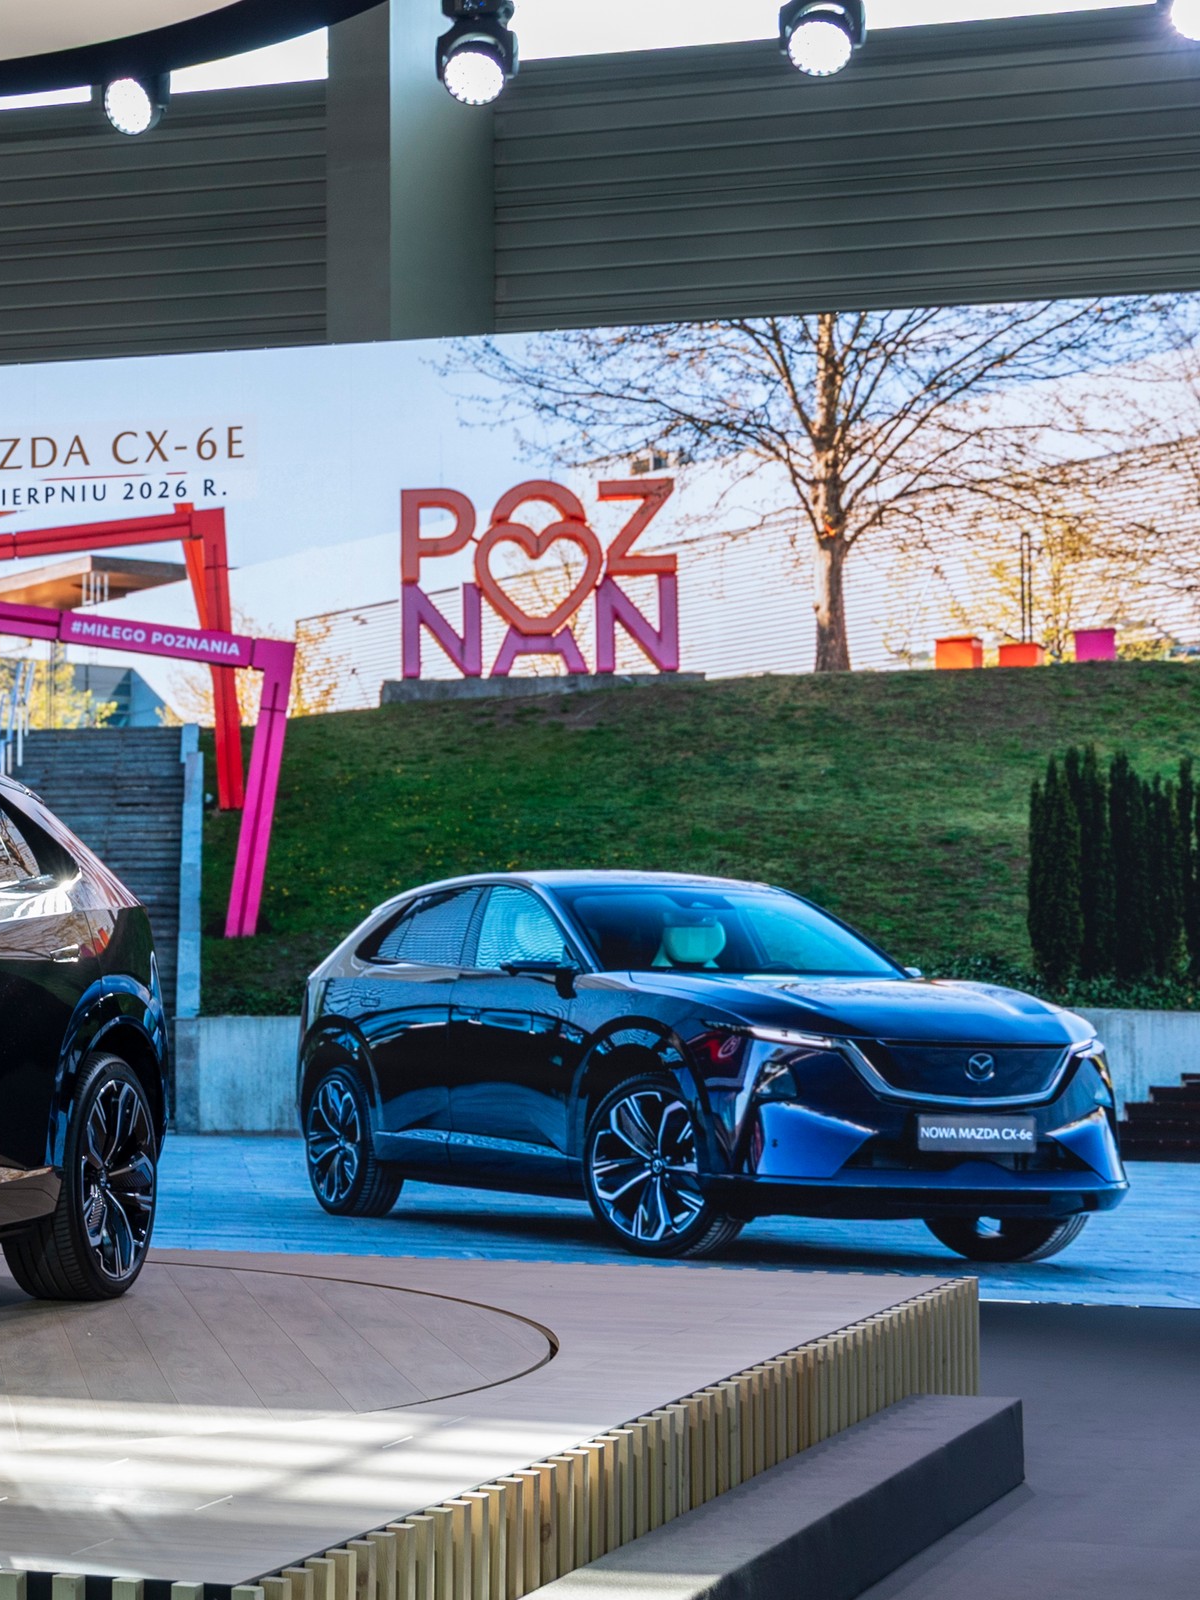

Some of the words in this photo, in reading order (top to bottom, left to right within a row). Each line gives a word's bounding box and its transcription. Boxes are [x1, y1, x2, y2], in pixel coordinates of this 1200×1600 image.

[111, 426, 245, 465] CX-6E
[123, 480, 187, 501] 2026
[202, 478, 228, 497] R.
[70, 621, 146, 643] #MIŁEGO
[151, 631, 240, 656] POZNANIA
[920, 1126, 956, 1139] NOWA
[958, 1127, 1000, 1140] MAZDA
[1001, 1128, 1033, 1141] CX-6e
